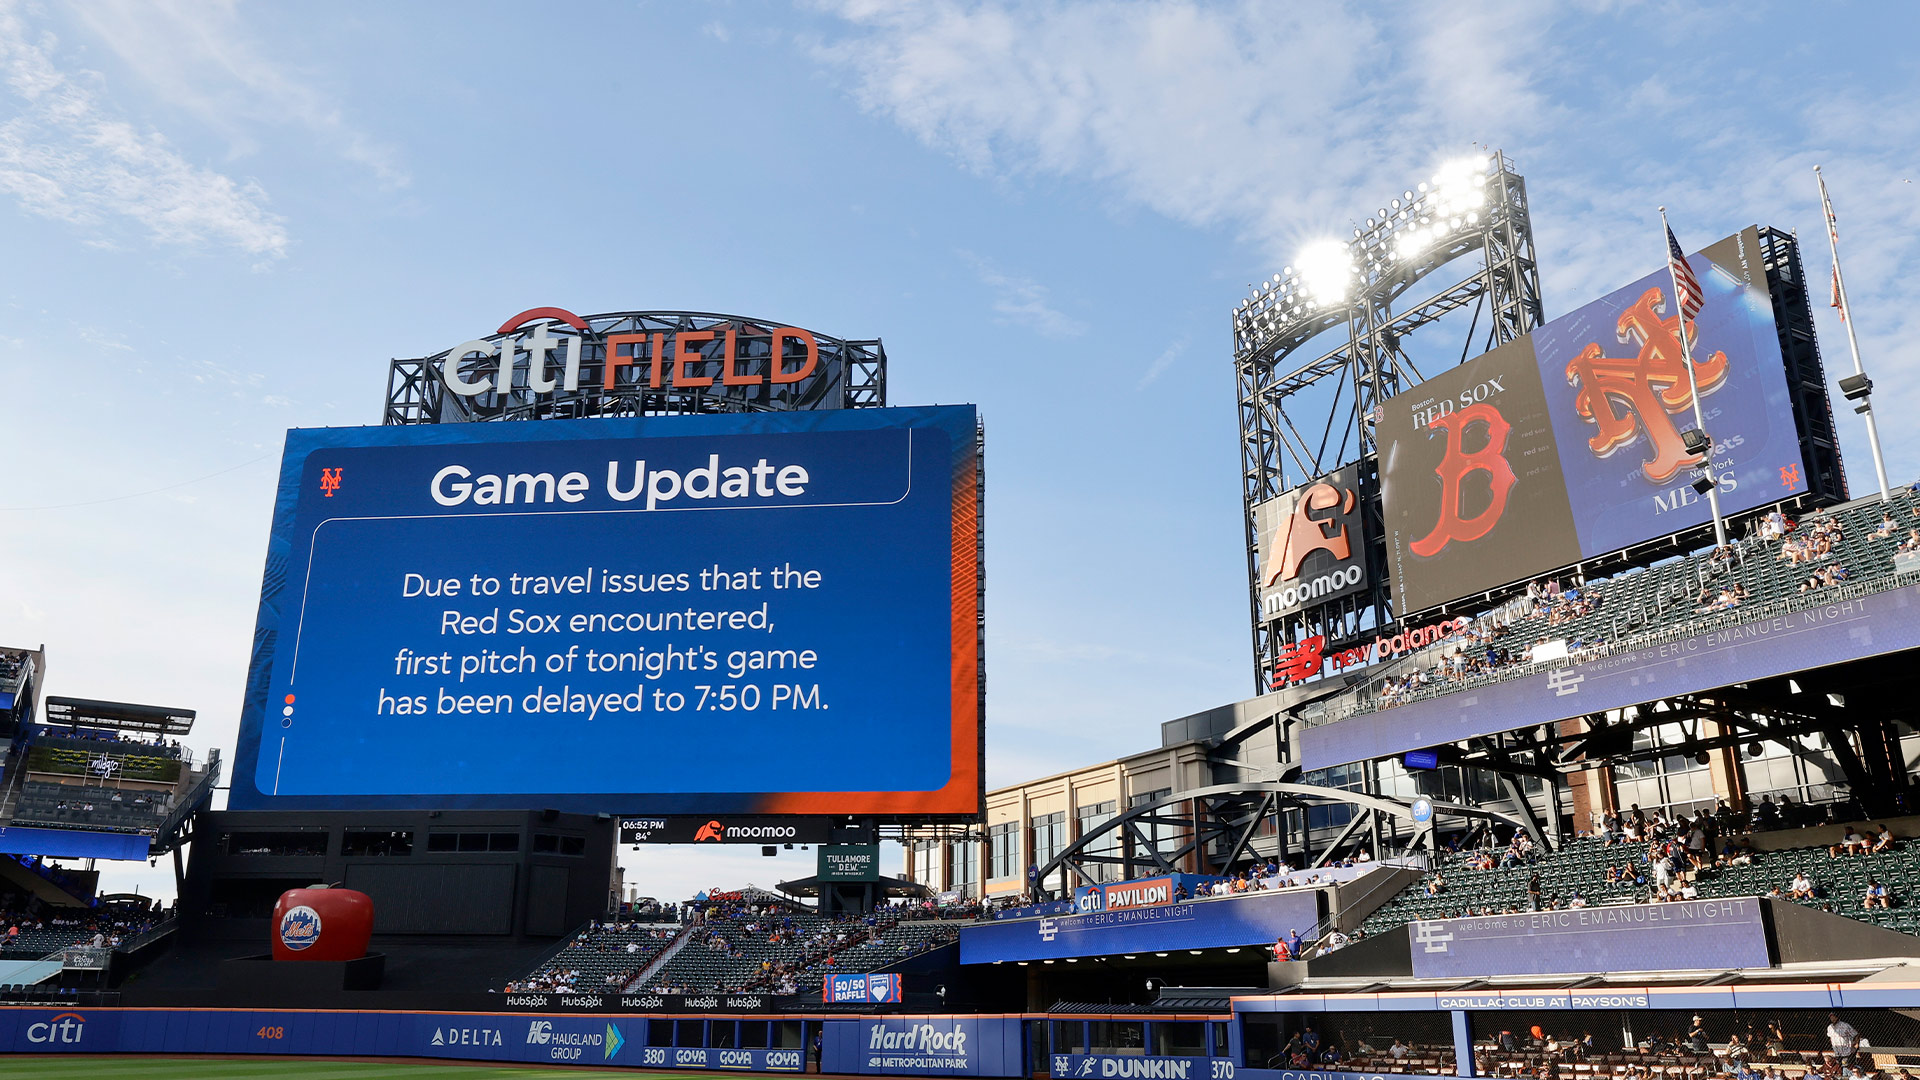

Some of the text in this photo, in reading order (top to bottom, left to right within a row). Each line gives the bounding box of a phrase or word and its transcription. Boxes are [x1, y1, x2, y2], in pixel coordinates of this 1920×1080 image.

[444, 307, 818, 396] citi FIELD
[1411, 397, 1435, 412] Boston
[1412, 374, 1506, 430] RED SOX
[1712, 457, 1735, 471] York
[431, 454, 809, 512] Game Update
[403, 562, 822, 597] Due to travel issues that the
[1265, 564, 1363, 615] moomoo
[441, 603, 774, 635] Red Sox encountered,
[1332, 616, 1469, 670] new balance
[1589, 654, 1637, 673] welcome
[1643, 650, 1655, 660] to
[1660, 639, 1699, 658] ERIC
[1706, 618, 1795, 647] EMANUEL
[1804, 598, 1868, 624] NIGHT
[394, 644, 818, 683] first pitch of tonight's game
[378, 684, 830, 721] has been delayed to 7:50 PM.
[622, 821, 664, 830] 06:52 PM
[727, 826, 796, 837] moomoo
[635, 831, 651, 841] 84°
[826, 855, 871, 863] TULLAMORE
[1080, 885, 1167, 911] citi PAVILION
[1095, 913, 1115, 925] ERIC
[1118, 908, 1160, 922] EMANUEL
[1164, 905, 1194, 917] NIGHT
[1458, 919, 1509, 932] welcome
[1512, 919, 1525, 929] to
[1531, 913, 1570, 929] ERIC
[1580, 906, 1672, 926] EMANUEL
[1681, 901, 1746, 919] NIGHT
[285, 921, 314, 937] Mets
[835, 979, 865, 992] 50/50
[506, 995, 548, 1008] HubSpot
[561, 995, 603, 1008] HubSpot
[621, 996, 663, 1009] HubSpot
[684, 996, 718, 1009] HubSpot
[726, 996, 762, 1009] HubSpot
[835, 990, 866, 1001] RAFFLE
[1440, 996, 1648, 1008] CADILLAC CLUB AT PAYSON'S
[27, 1013, 86, 1043] citi
[257, 1026, 284, 1040] 408
[448, 1028, 502, 1046] DELTA
[551, 1033, 602, 1046] HAUGLAND
[869, 1024, 966, 1055] Hard Rock
[551, 1047, 582, 1060] GROUP
[643, 1049, 665, 1064] 380
[676, 1050, 707, 1064] GOYA
[719, 1051, 752, 1065] GOYA
[766, 1052, 800, 1066] GOYA
[882, 1057, 967, 1069] METROPOLITAN PARK
[1102, 1058, 1191, 1080] DUNKIN'
[1211, 1061, 1235, 1079] 370
